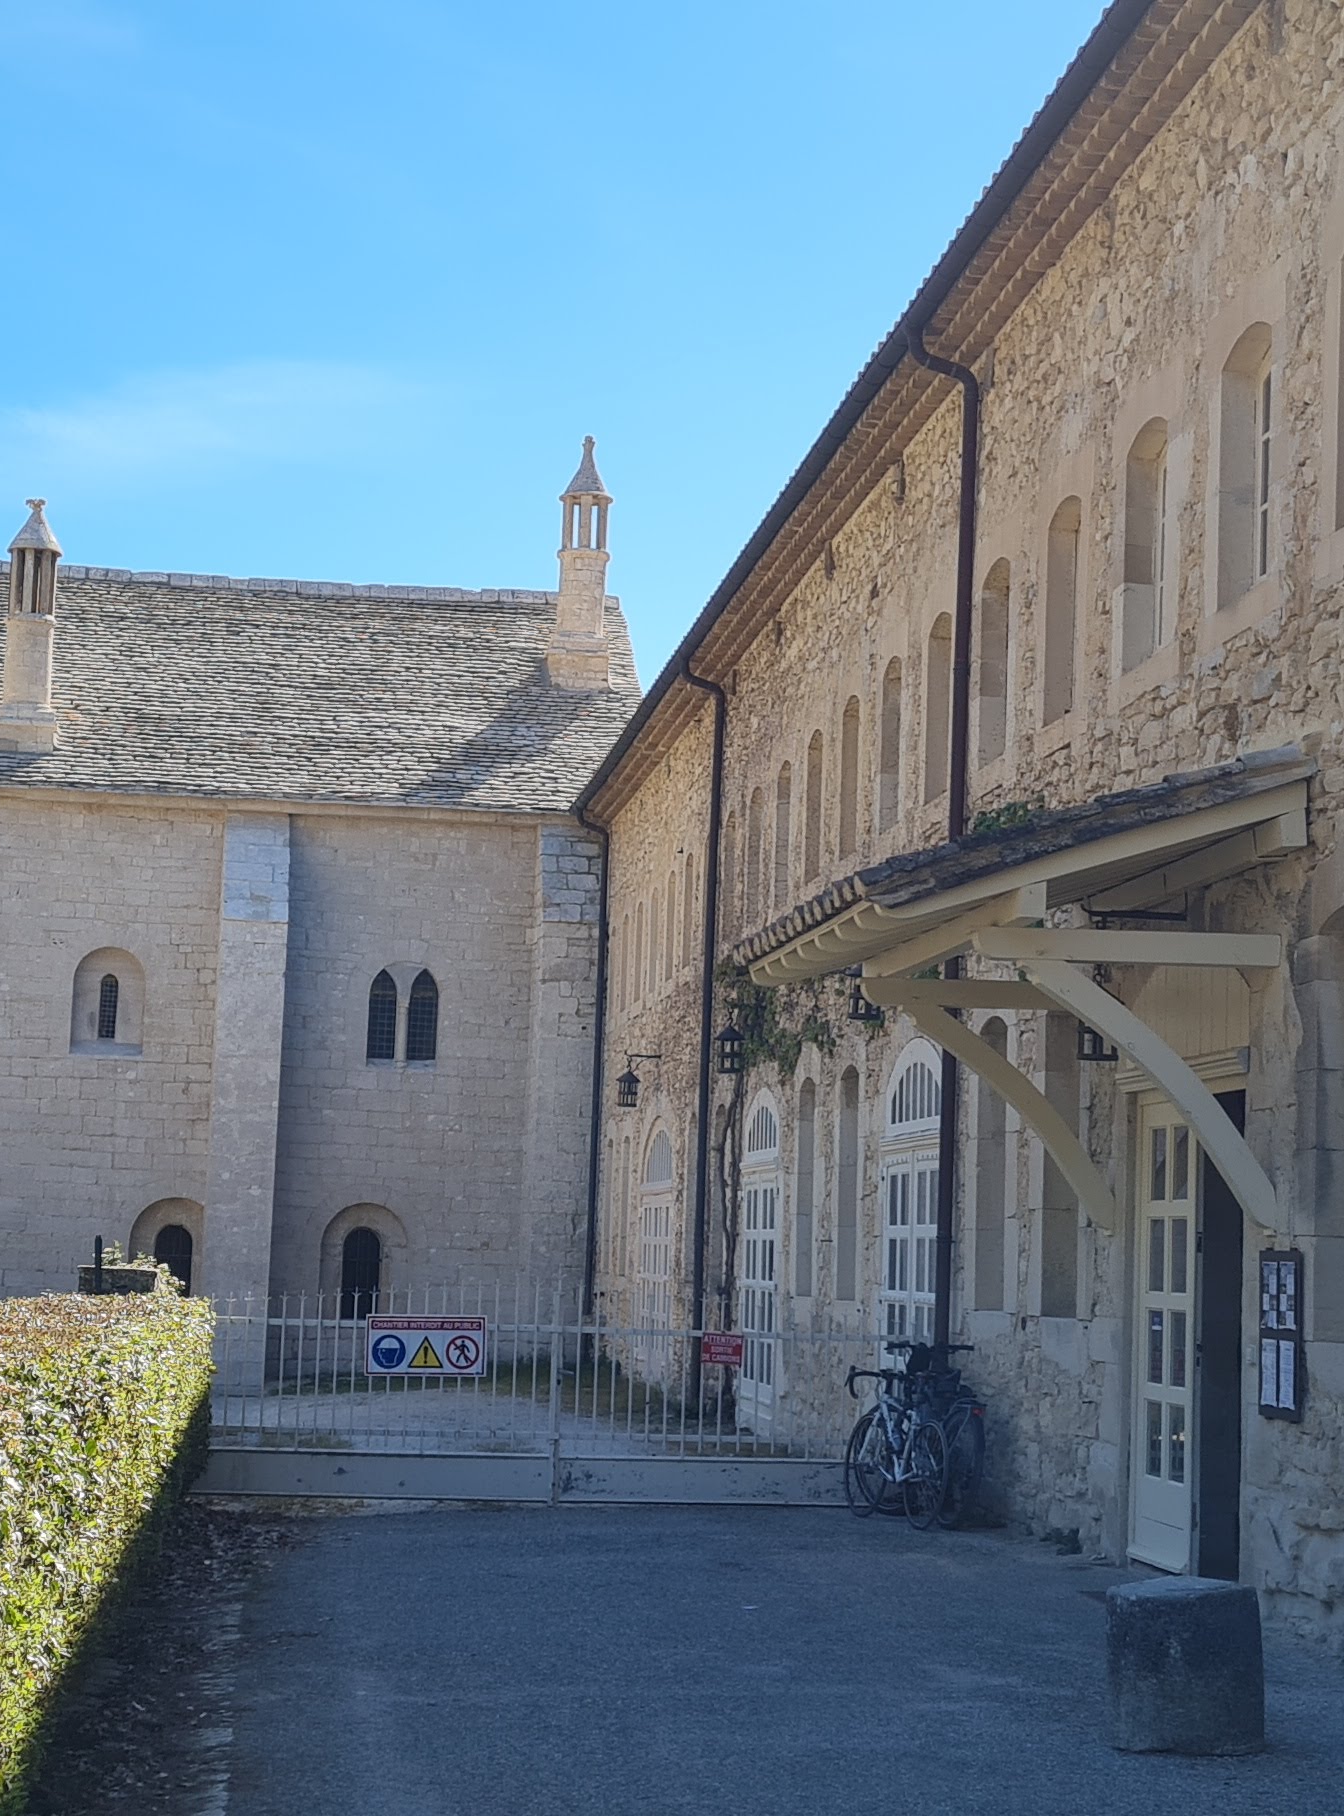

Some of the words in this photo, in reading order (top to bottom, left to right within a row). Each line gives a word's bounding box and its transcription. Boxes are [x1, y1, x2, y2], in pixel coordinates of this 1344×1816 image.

[373, 1321, 408, 1329] CHANTIER
[410, 1321, 441, 1329] INTERDIT
[454, 1322, 480, 1330] PUBLIC
[703, 1334, 742, 1345] ATTENTION
[711, 1345, 733, 1354] SORTIE
[702, 1353, 710, 1361] DE
